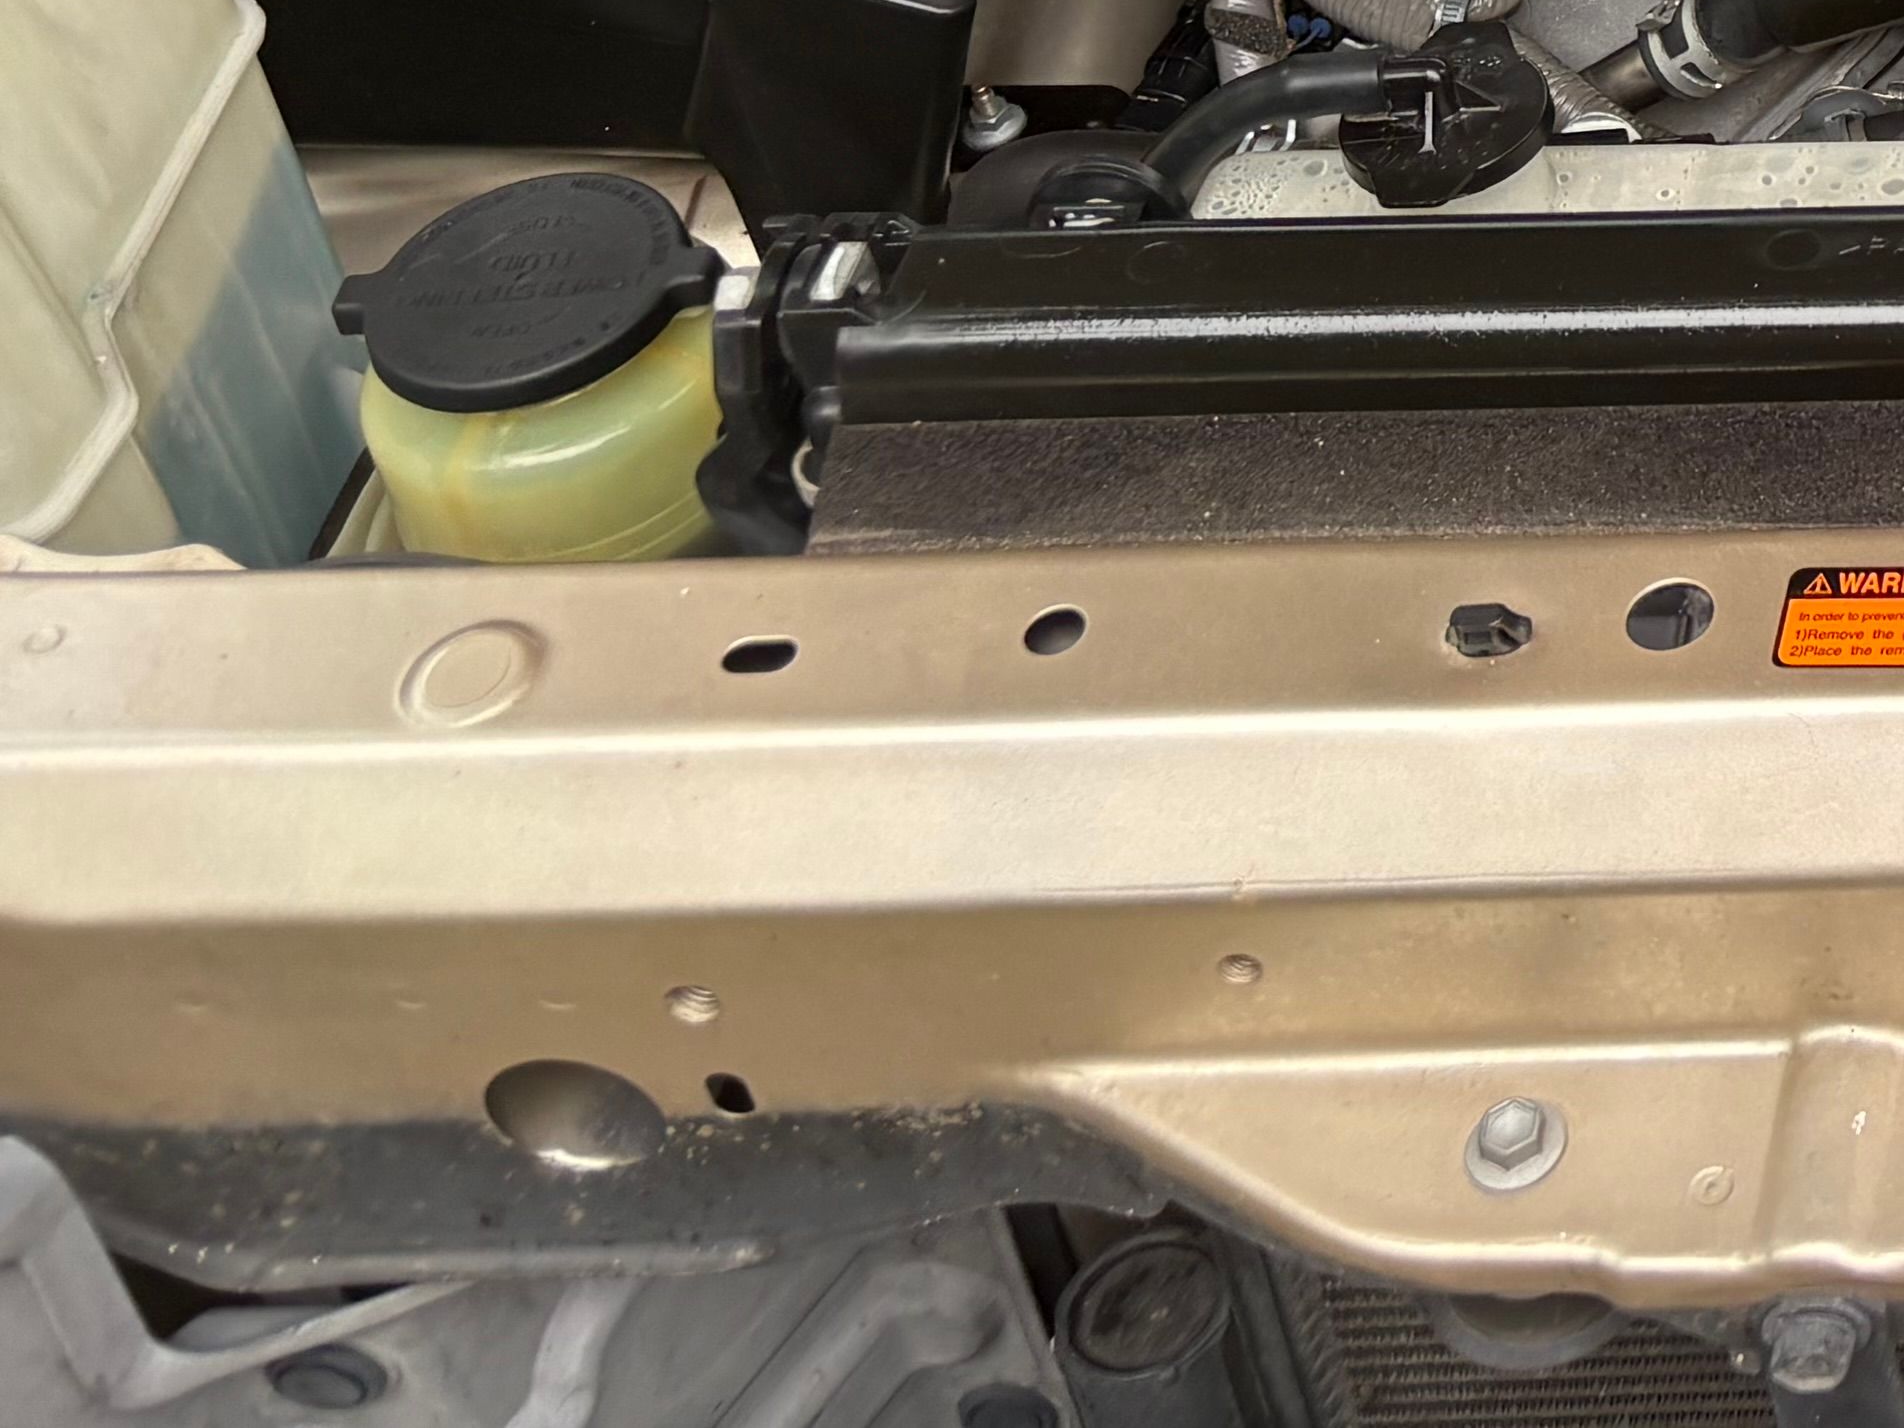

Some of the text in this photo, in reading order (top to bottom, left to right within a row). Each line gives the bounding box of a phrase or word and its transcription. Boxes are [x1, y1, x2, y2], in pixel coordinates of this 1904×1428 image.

[1799, 611, 1811, 622] In
[1813, 610, 1845, 622] order
[1848, 611, 1859, 622] to
[1795, 628, 1864, 642] 1)Remove
[1872, 628, 1894, 640] the
[1789, 645, 1842, 658] 2)Place
[1851, 644, 1872, 656] the
